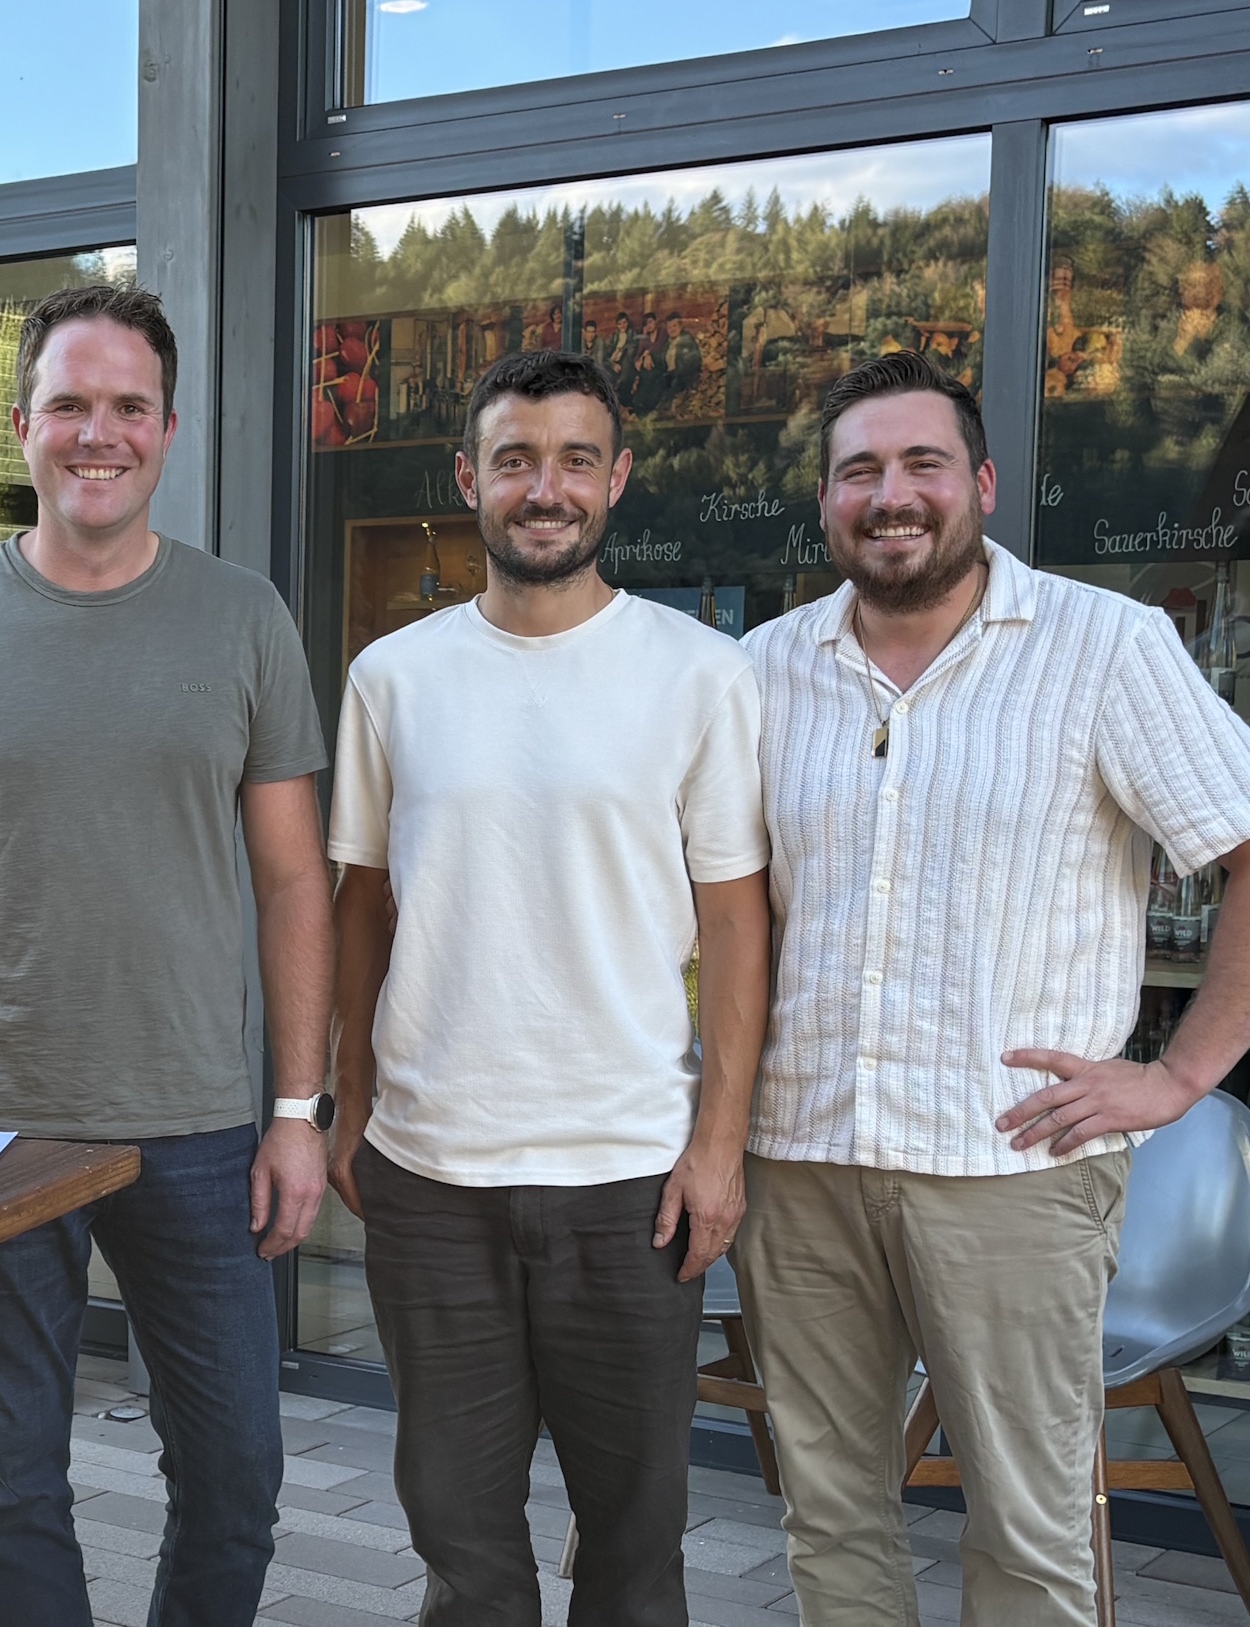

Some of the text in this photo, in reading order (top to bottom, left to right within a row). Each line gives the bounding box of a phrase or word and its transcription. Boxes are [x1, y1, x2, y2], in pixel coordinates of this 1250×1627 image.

[699, 490, 786, 522] Kirsche
[1093, 506, 1239, 555] Sauerkirsche
[599, 528, 683, 575] Aprikose
[181, 683, 213, 692] BOSS
